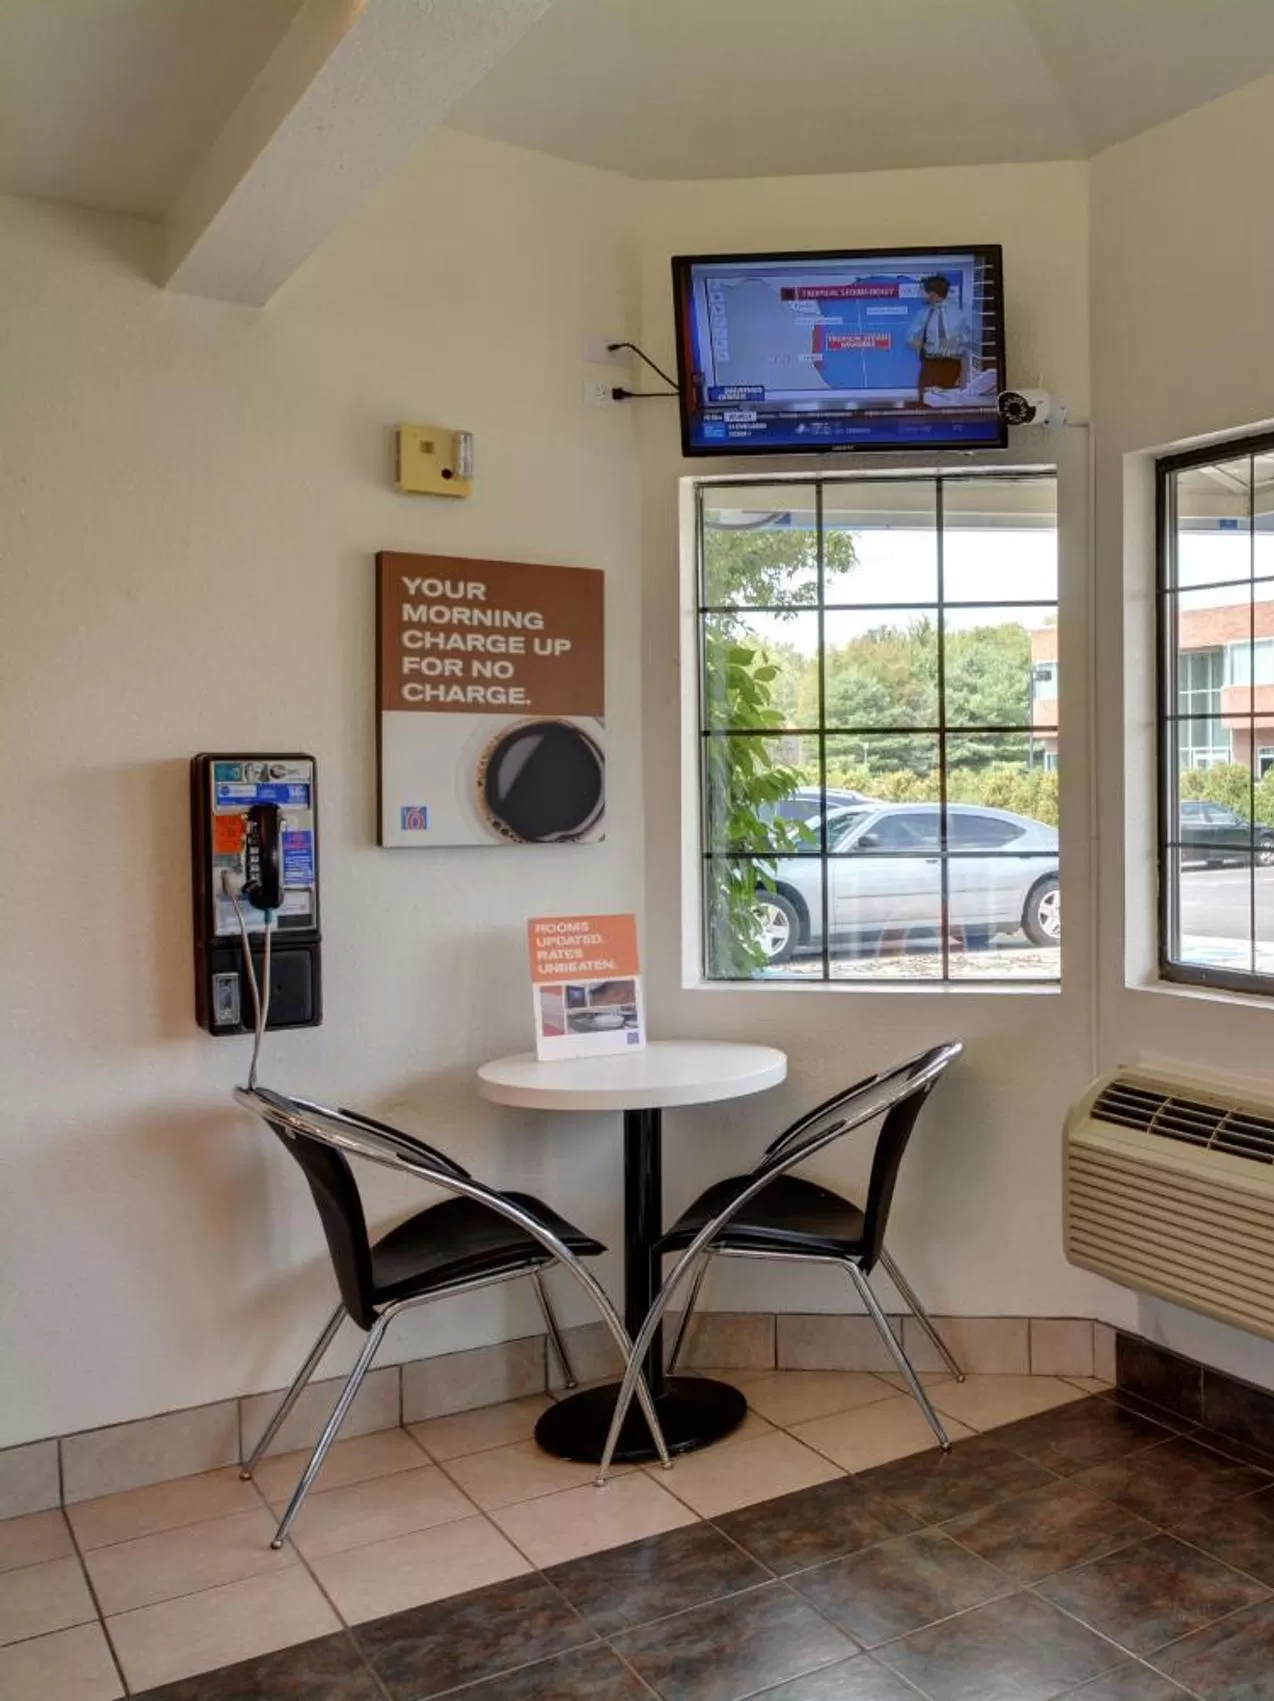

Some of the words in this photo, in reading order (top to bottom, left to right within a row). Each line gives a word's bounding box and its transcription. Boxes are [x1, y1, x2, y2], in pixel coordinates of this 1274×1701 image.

[401, 576, 486, 600] YOUR
[402, 603, 545, 630] MORNING
[402, 629, 525, 655] CHARGE
[533, 638, 572, 656] UP
[402, 656, 463, 678] FOR
[472, 660, 515, 679] NO
[402, 682, 532, 705] CHARGE.
[535, 921, 590, 934] ROOMS
[537, 947, 584, 960] RATES
